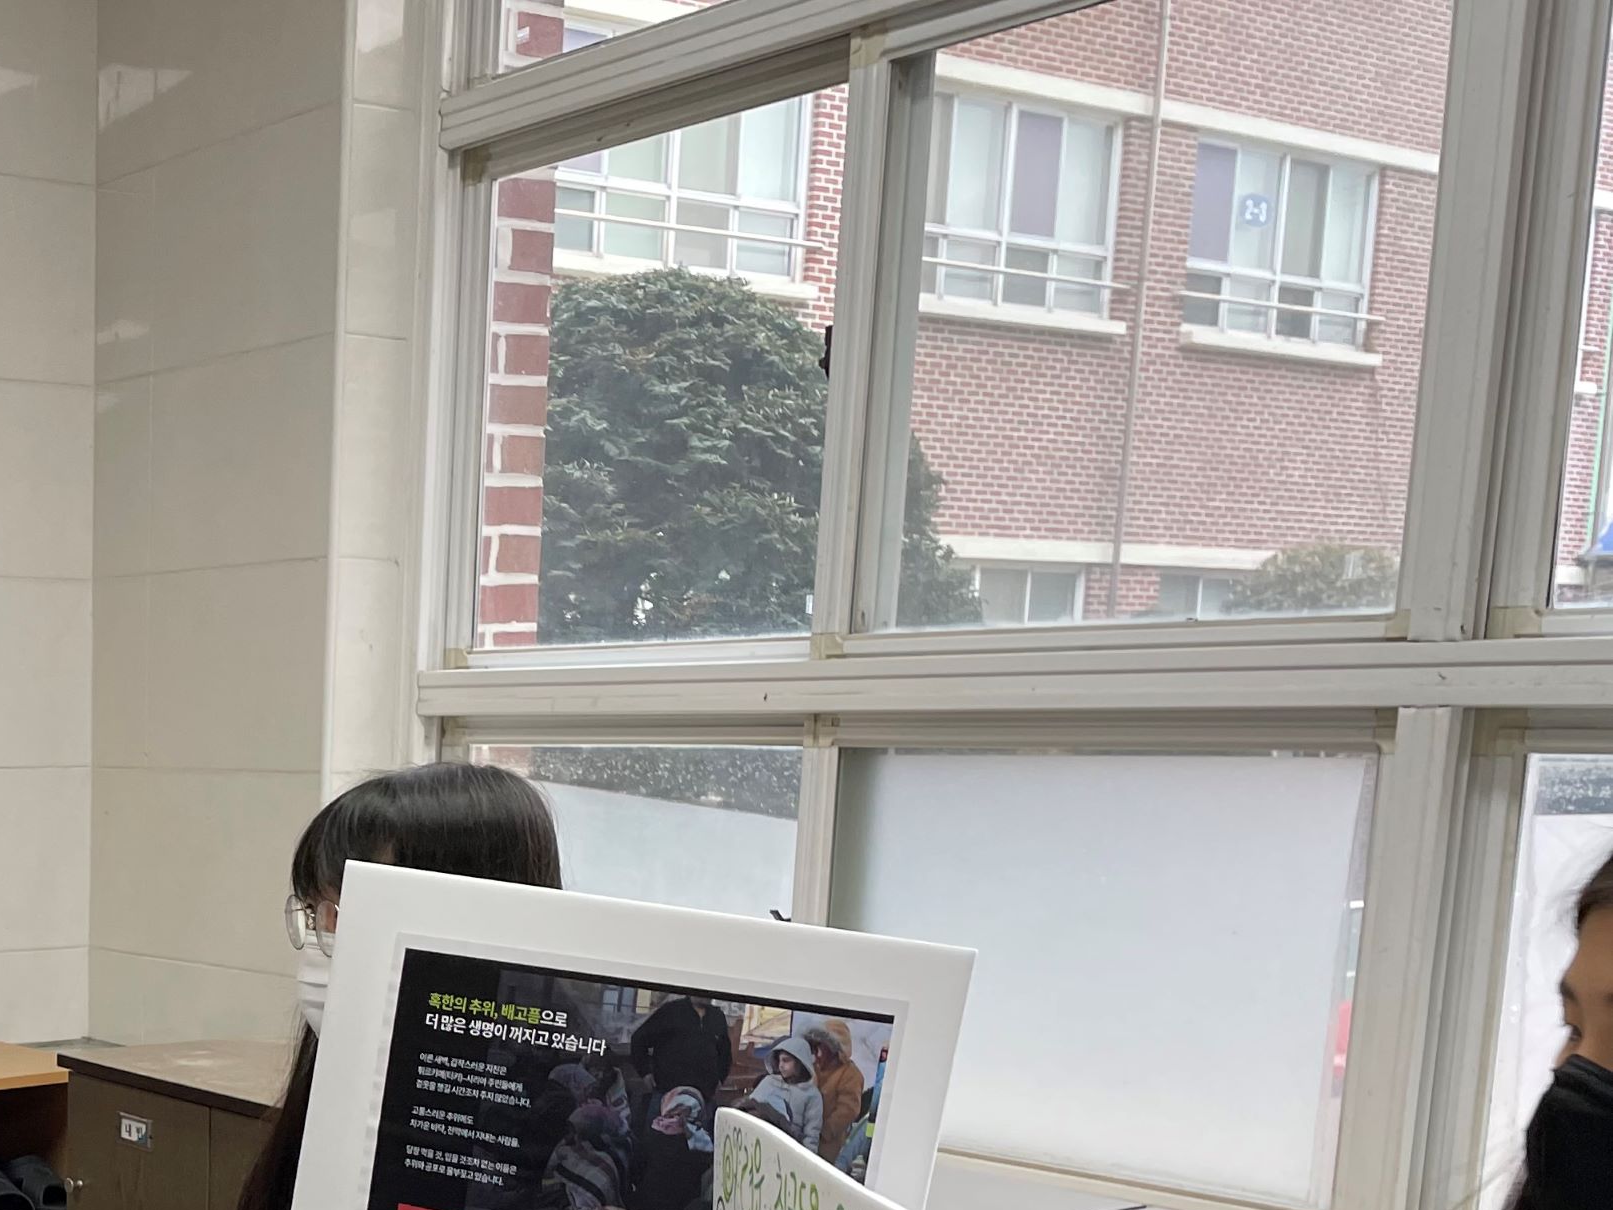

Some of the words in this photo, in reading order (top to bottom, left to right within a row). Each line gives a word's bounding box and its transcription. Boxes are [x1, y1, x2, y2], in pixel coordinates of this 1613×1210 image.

[1245, 199, 1267, 222] 2-3
[429, 993, 467, 1013] 혹한의
[469, 999, 498, 1019] 추위,
[502, 1003, 568, 1027] 배고픔으로
[425, 1013, 439, 1029] 더
[440, 1014, 466, 1034] 많은
[468, 1019, 507, 1041] 생명이
[509, 1027, 549, 1046] 꺼지고
[551, 1032, 607, 1056] 있습니다
